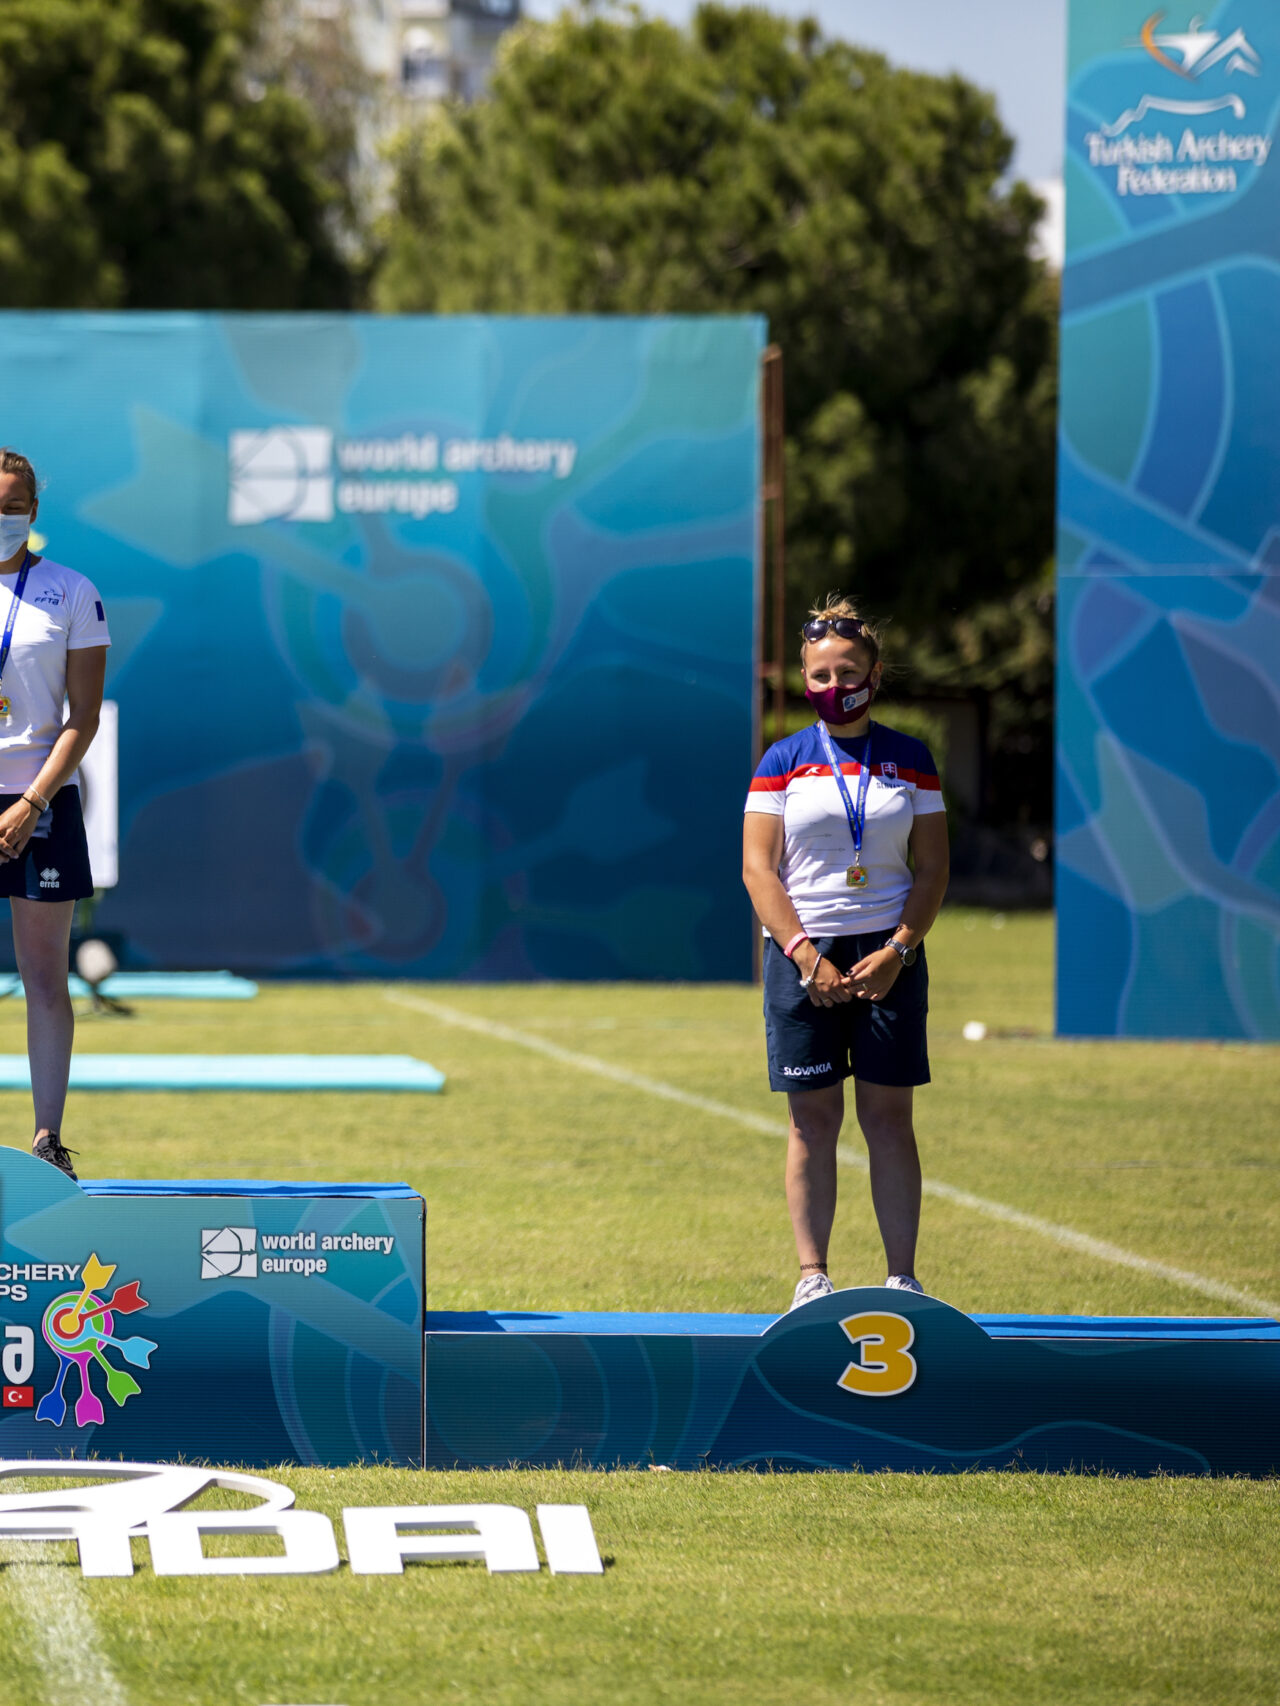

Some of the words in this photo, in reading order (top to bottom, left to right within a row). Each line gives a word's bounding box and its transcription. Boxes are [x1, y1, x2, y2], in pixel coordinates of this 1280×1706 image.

[1085, 132, 1173, 166] Turkish
[1176, 127, 1272, 166] Archery
[1117, 162, 1237, 196] Federation
[337, 433, 438, 471] world
[443, 433, 577, 478] archery
[337, 479, 458, 520] europe
[783, 1062, 833, 1076] SLOVAKIA
[262, 1232, 316, 1250] world
[321, 1232, 394, 1254] archery
[261, 1258, 327, 1276] europe
[837, 1311, 917, 1397] 3
